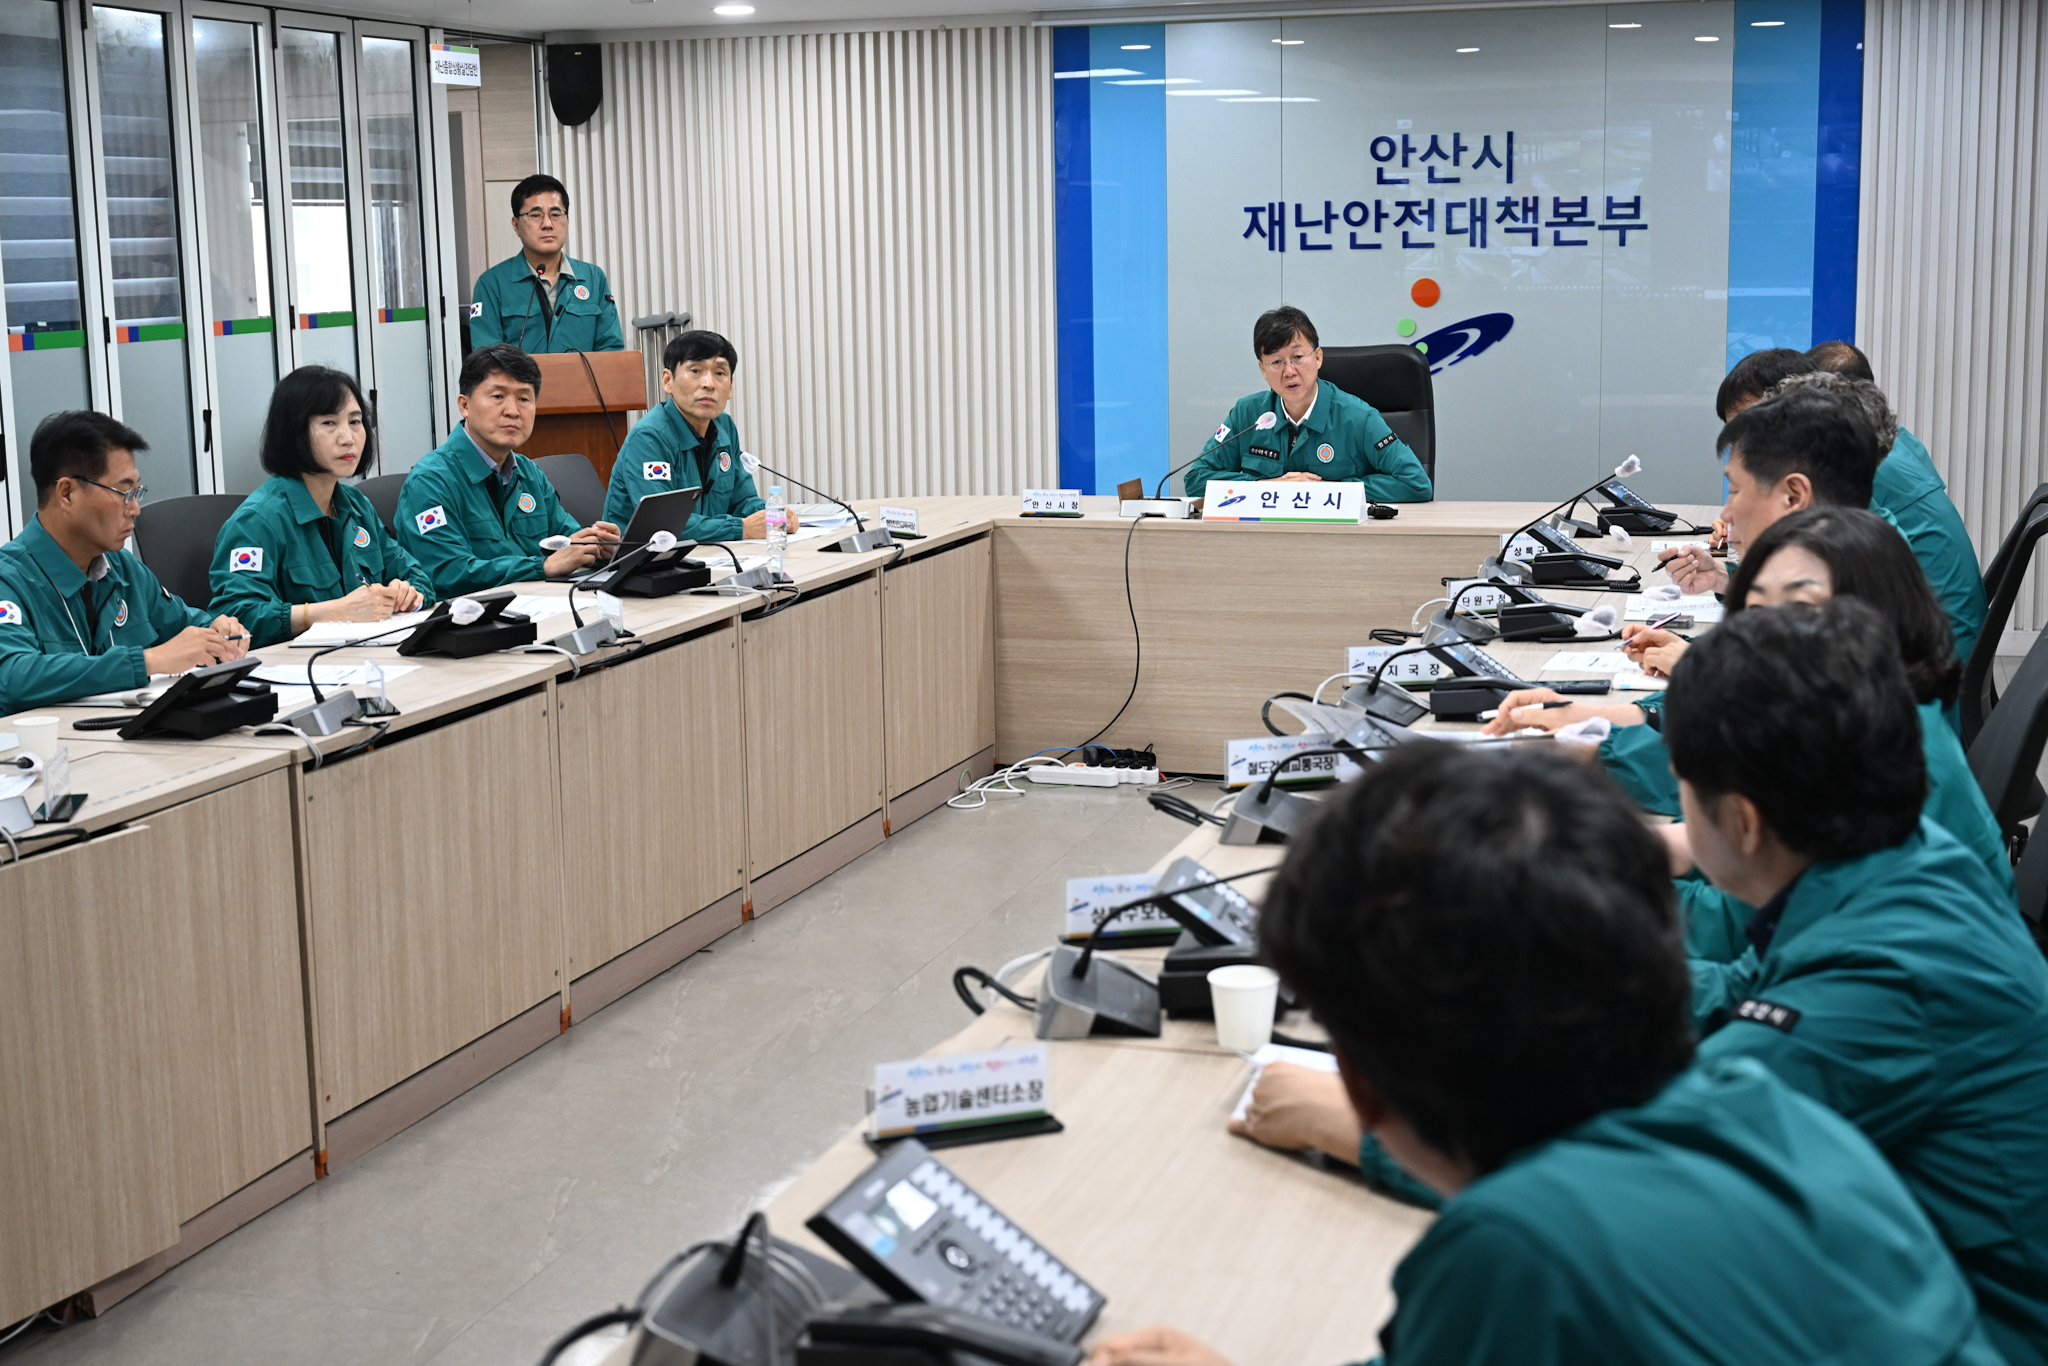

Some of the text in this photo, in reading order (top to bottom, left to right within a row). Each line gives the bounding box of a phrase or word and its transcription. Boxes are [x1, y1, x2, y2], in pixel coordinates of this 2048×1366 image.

[1370, 131, 1514, 185] 안산시
[1243, 195, 1648, 252] 재난안전대책본부
[1032, 500, 1078, 510] 안산시장
[1260, 491, 1342, 510] 안산시
[904, 1078, 1044, 1118] 농업기술센터소장
